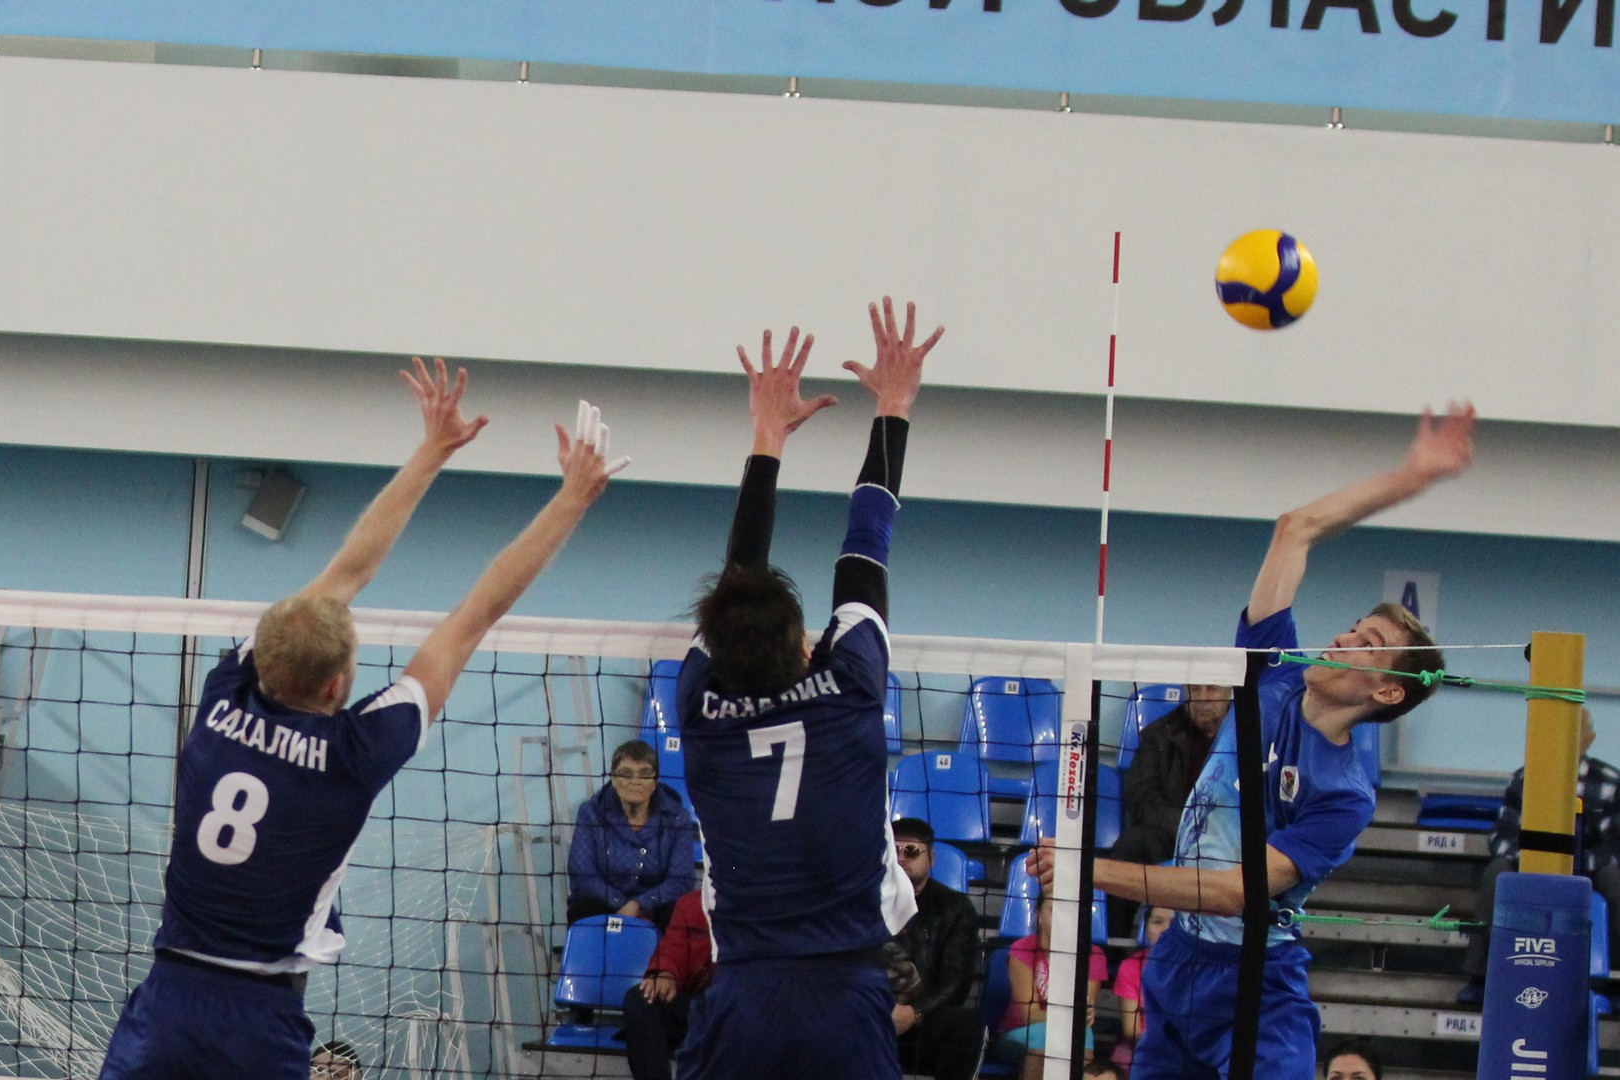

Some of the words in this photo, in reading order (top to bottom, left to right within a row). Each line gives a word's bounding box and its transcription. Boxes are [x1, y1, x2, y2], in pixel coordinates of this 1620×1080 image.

[1401, 581, 1420, 621] А
[206, 699, 328, 772] САХАЛИН
[747, 720, 806, 821] 7
[197, 771, 269, 865] 8
[1428, 837, 1447, 848] РЯД
[1446, 1018, 1466, 1031] РЯД
